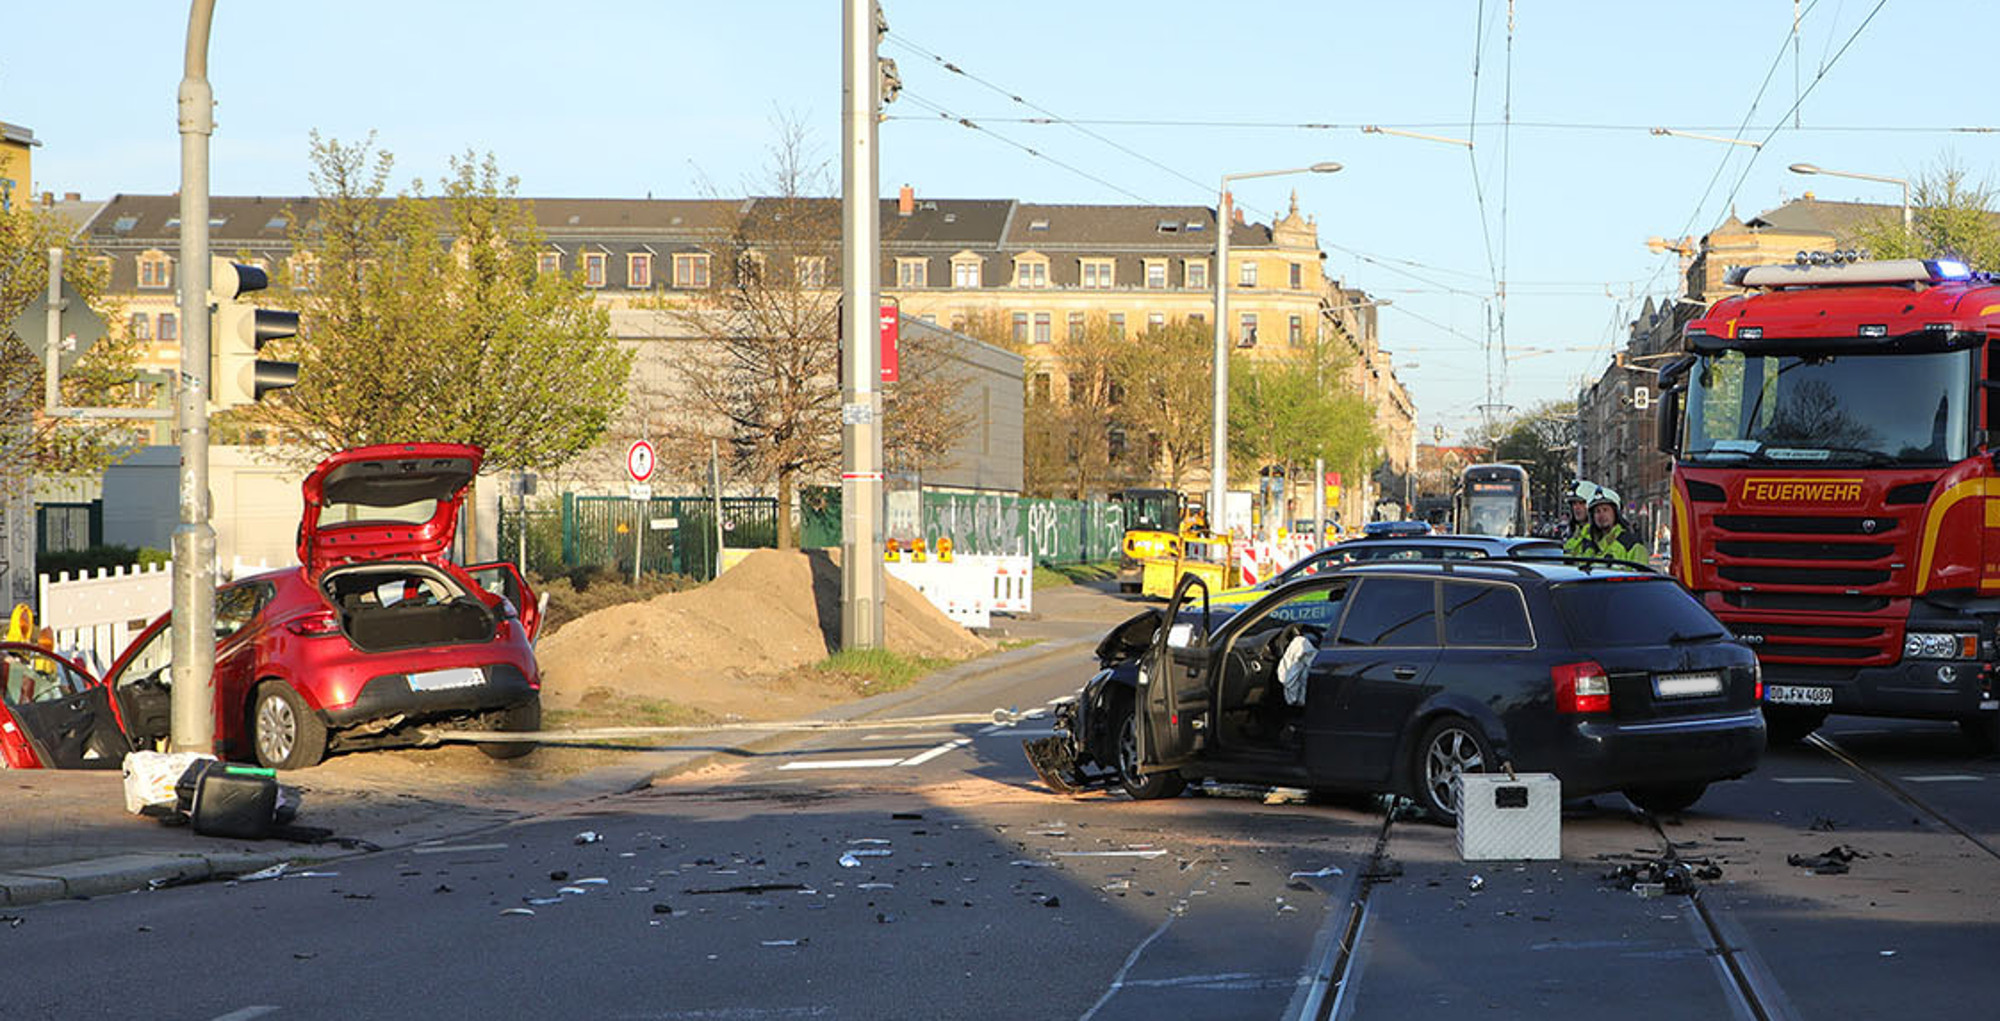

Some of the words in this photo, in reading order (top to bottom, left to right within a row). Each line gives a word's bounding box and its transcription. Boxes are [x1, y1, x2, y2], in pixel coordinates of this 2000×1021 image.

[1726, 318, 1737, 339] 1
[1742, 478, 1863, 500] FEUERWEHR
[1269, 606, 1326, 621] POLIZEI
